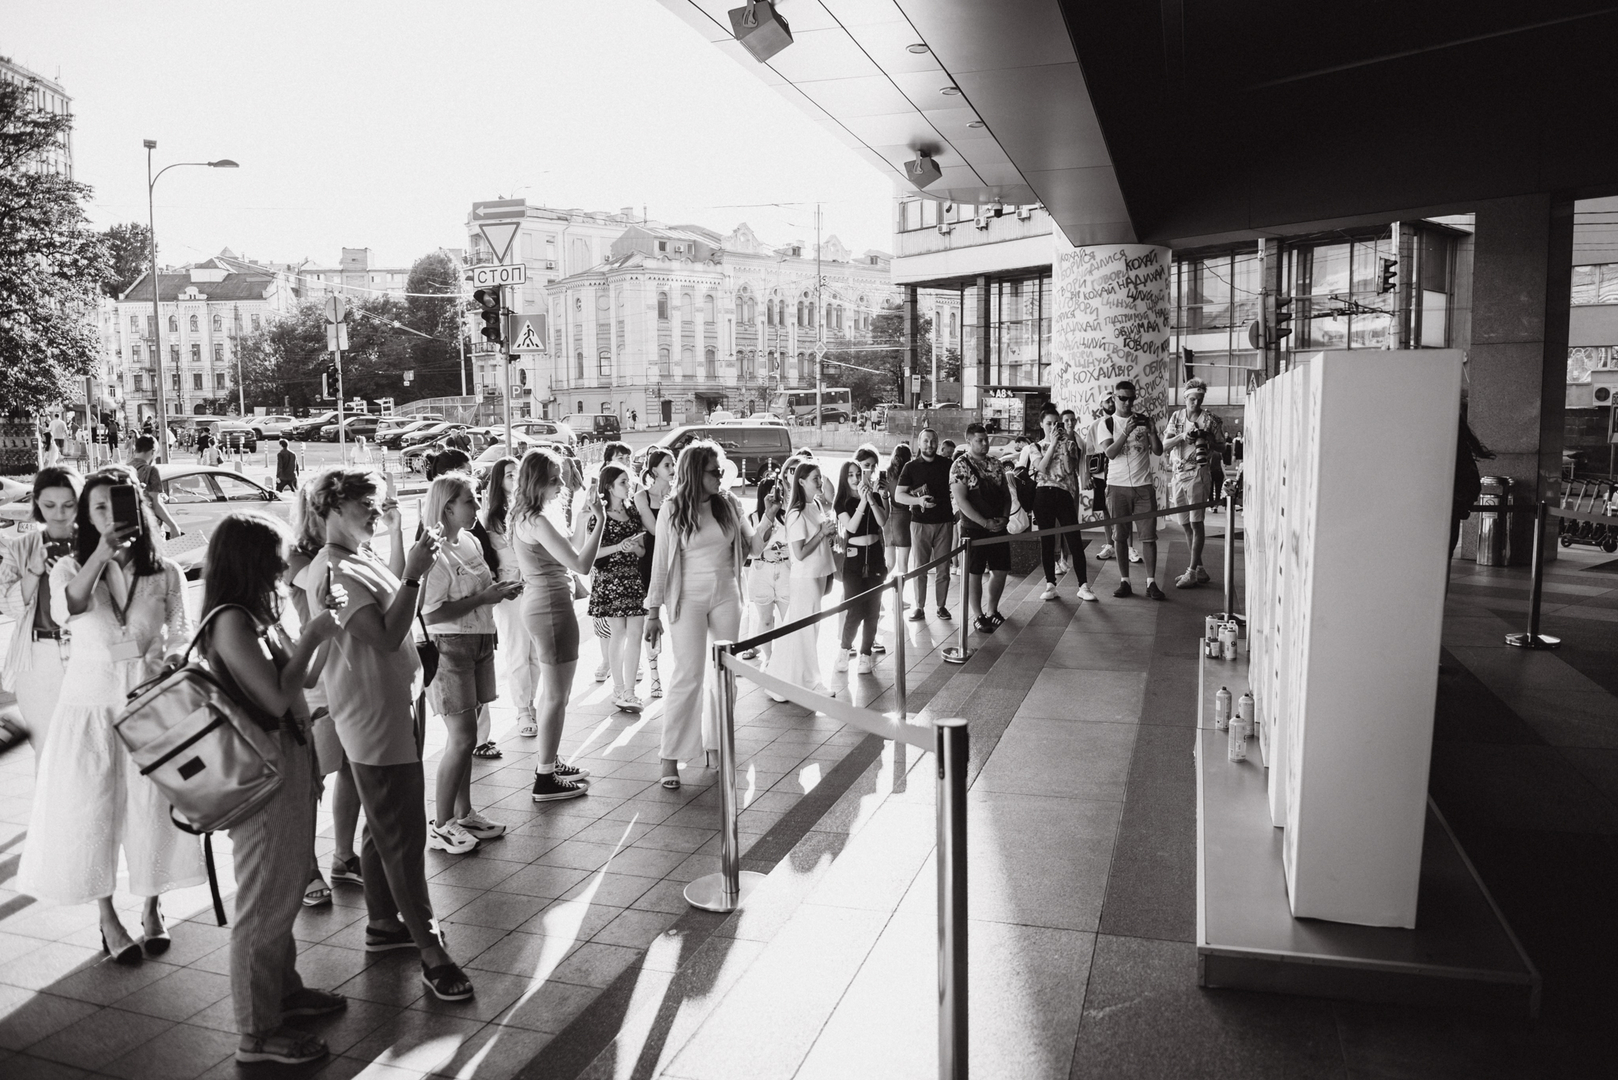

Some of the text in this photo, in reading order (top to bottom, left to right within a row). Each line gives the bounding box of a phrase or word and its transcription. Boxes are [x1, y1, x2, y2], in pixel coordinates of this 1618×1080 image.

[1060, 248, 1086, 263] КОХАЙ
[1124, 249, 1158, 271] КОХАЙ
[478, 267, 521, 284] СТОП
[1116, 265, 1165, 290] НАДИХАЙ
[1083, 283, 1117, 300] КОХАЙ
[1104, 310, 1150, 327] ПІДТРИМУЙ
[1114, 319, 1160, 339] ОБІЙМАЙ
[1080, 336, 1106, 351] ЦІЛУЙ
[1123, 337, 1160, 358] ГОВОРИ
[1104, 342, 1138, 366] ТВОРИ
[1073, 363, 1117, 385] КОХАЙ
[512, 386, 521, 398] P
